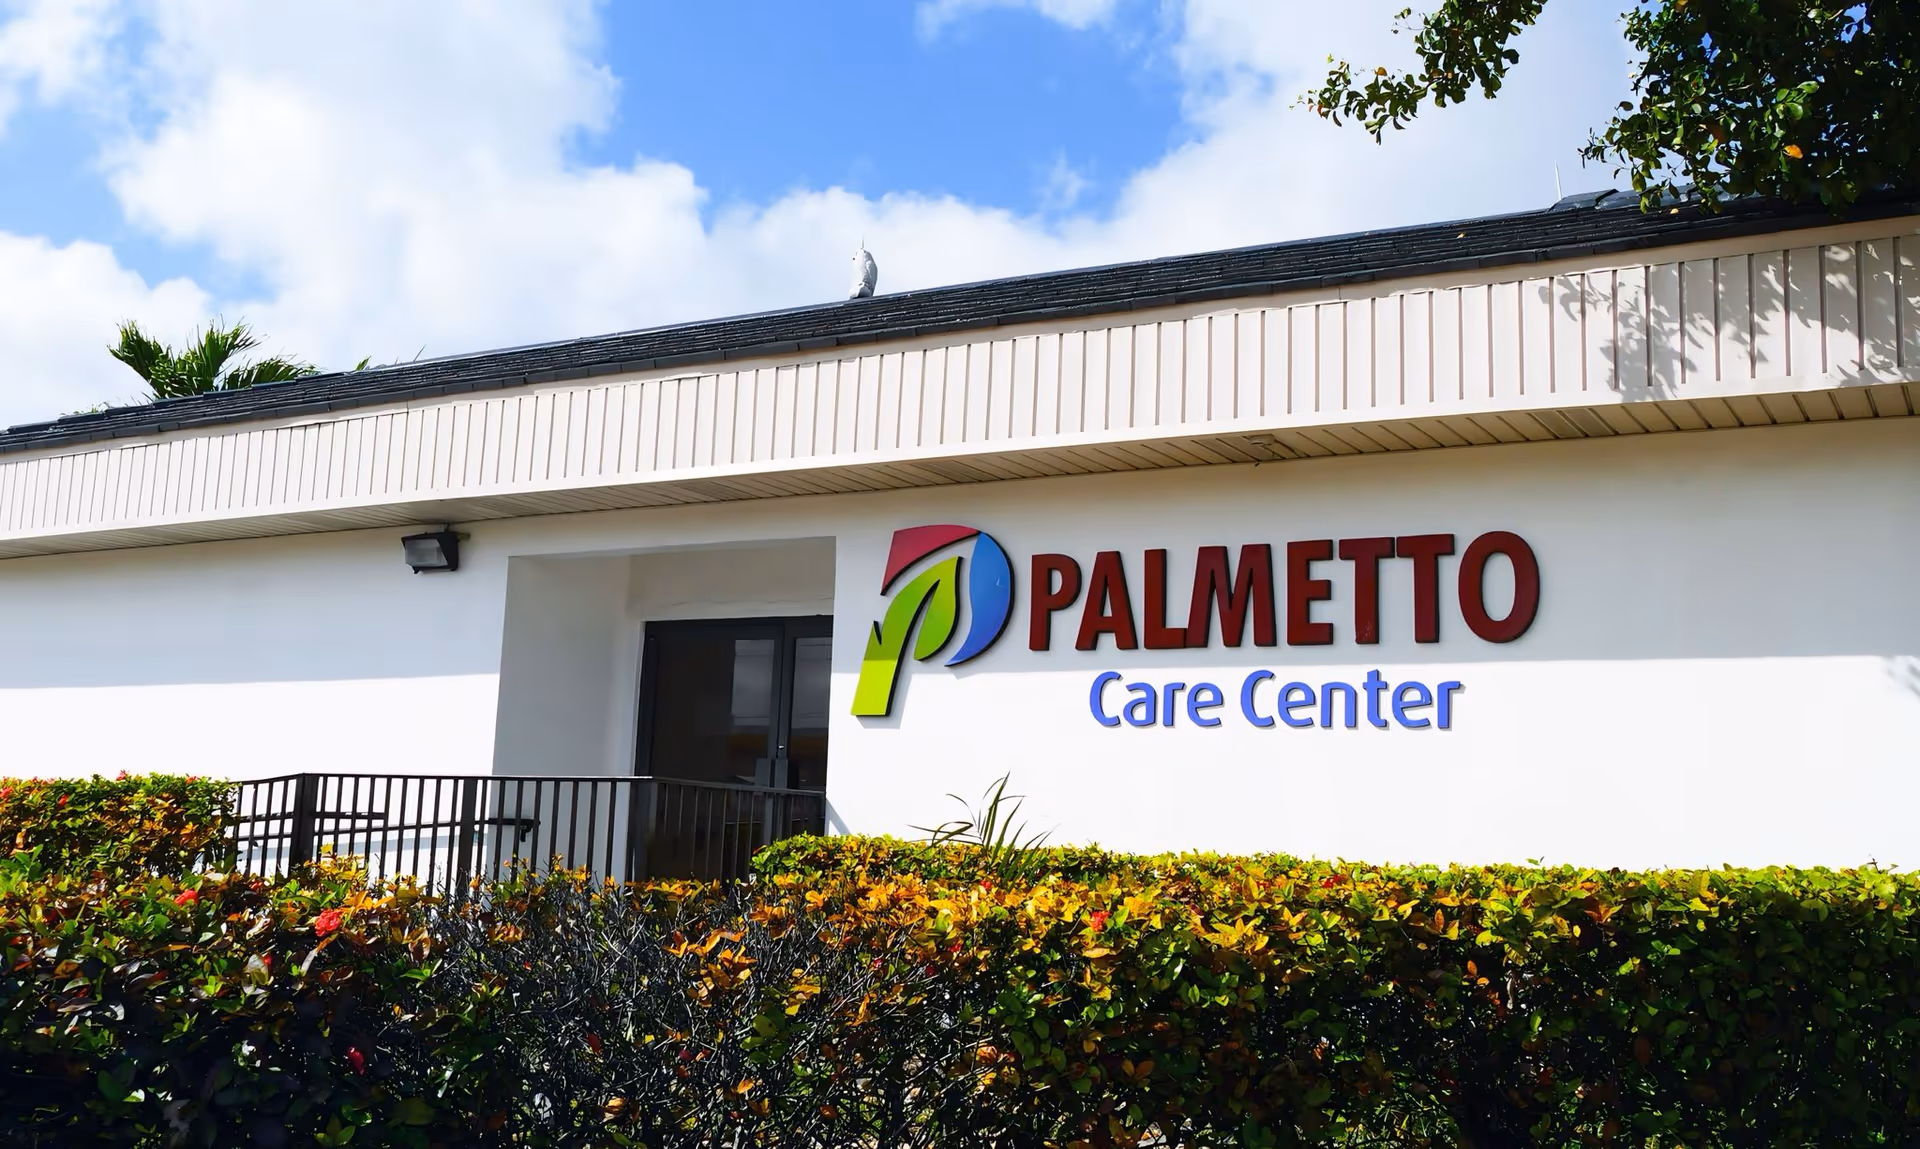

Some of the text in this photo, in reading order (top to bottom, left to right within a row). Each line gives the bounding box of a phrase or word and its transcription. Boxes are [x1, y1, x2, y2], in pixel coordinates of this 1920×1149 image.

[1028, 530, 1541, 652] PALMETTO
[1088, 668, 1463, 730] Care Center
